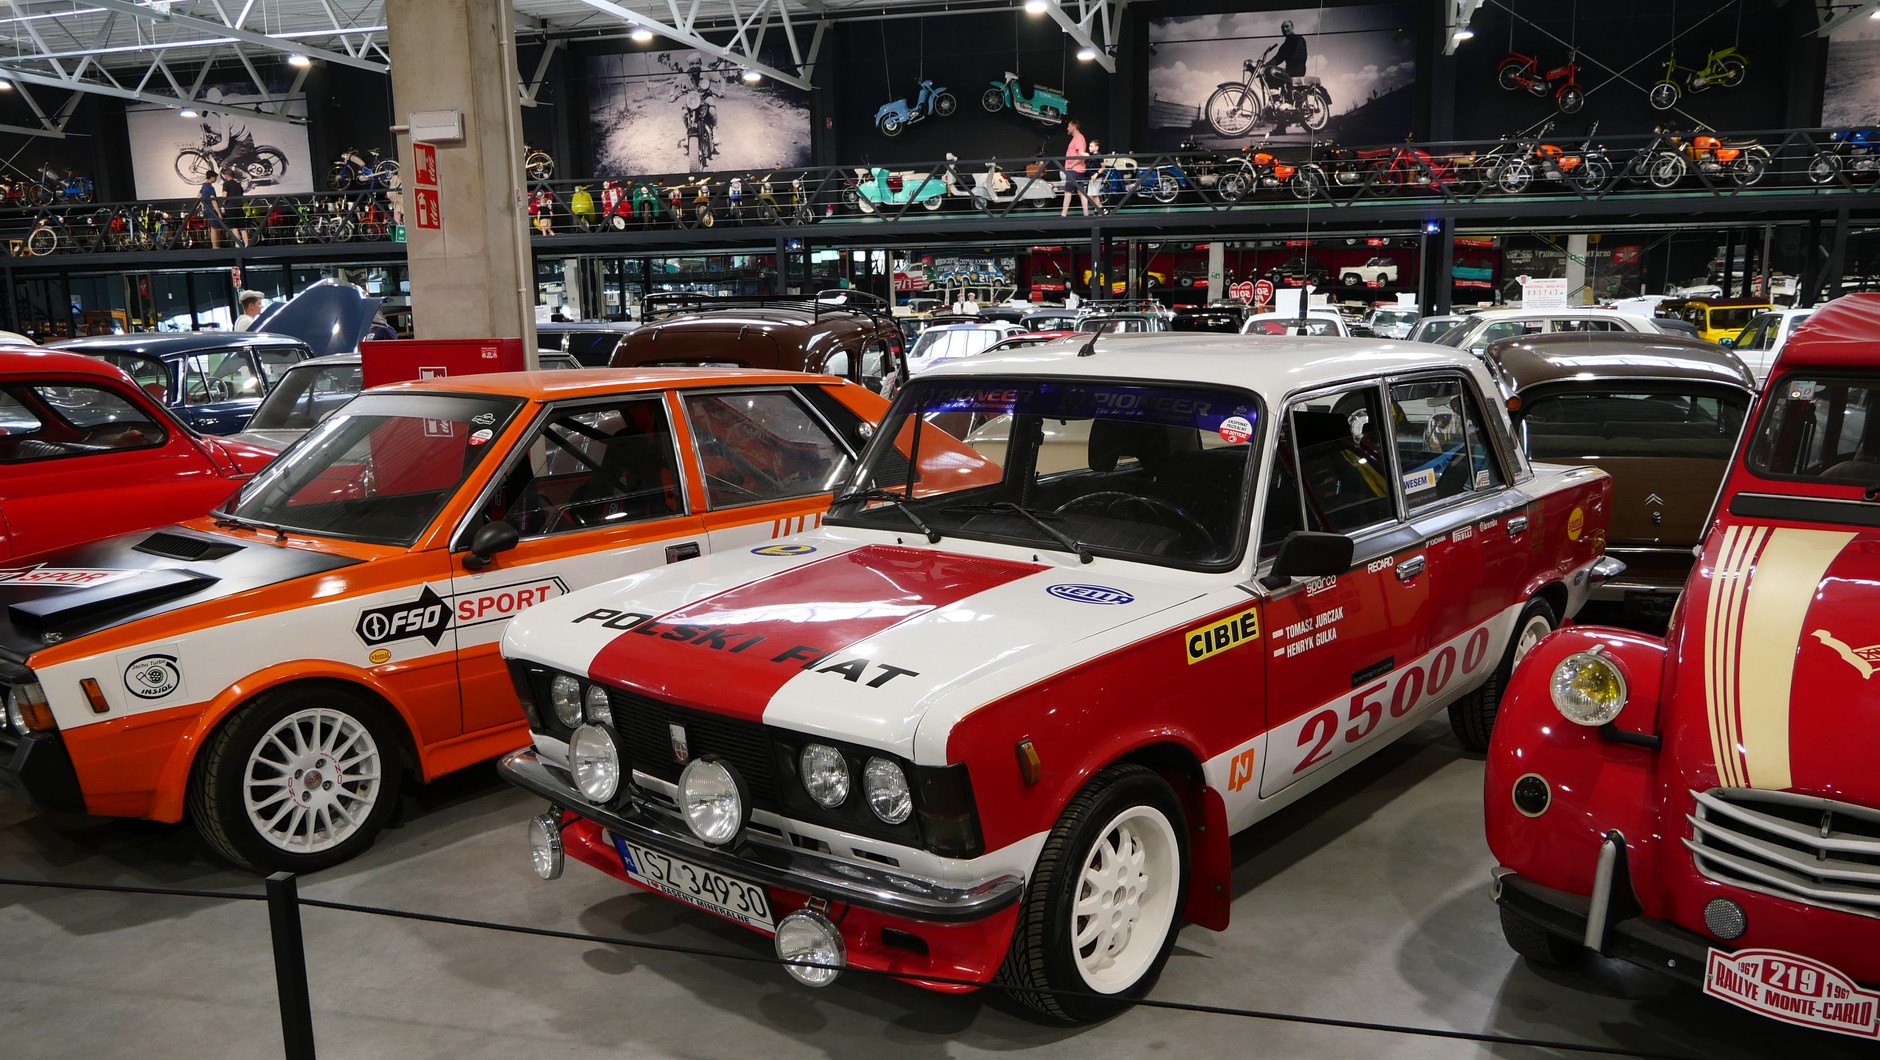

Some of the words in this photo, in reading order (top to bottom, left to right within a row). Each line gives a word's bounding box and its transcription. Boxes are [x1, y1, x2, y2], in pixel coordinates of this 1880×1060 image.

[249, 164, 263, 175] 29
[935, 389, 1035, 402] PIONEER
[1092, 392, 1212, 416] PIONEER
[1404, 475, 1428, 490] WESEM
[1452, 525, 1472, 543] PIRELLI
[1367, 556, 1394, 574] RECARO
[1053, 585, 1135, 605] HELLA
[1306, 575, 1337, 597] sparco
[457, 585, 551, 621] SPORT
[389, 604, 442, 636] FSO
[571, 607, 767, 653] POLSKI
[1285, 617, 1314, 640] TOMASZ
[1315, 606, 1344, 629] JURCZAK
[1286, 637, 1314, 659] HENRYK
[1316, 627, 1338, 647] GULKA
[769, 645, 921, 689] FIAT
[141, 683, 173, 695] INSIDE
[1291, 626, 1490, 775] 25000
[625, 856, 635, 868] PL
[627, 844, 681, 889] TSZ
[681, 864, 767, 919] 34930
[660, 885, 694, 904] BASENY
[697, 899, 752, 925] MINERALNE
[1715, 960, 1760, 1002] RALLYE
[1764, 988, 1874, 1027] MONTE-CARLO
[1737, 961, 1760, 979] 1967
[1768, 960, 1817, 995] 219
[1826, 981, 1850, 1000] 1967
